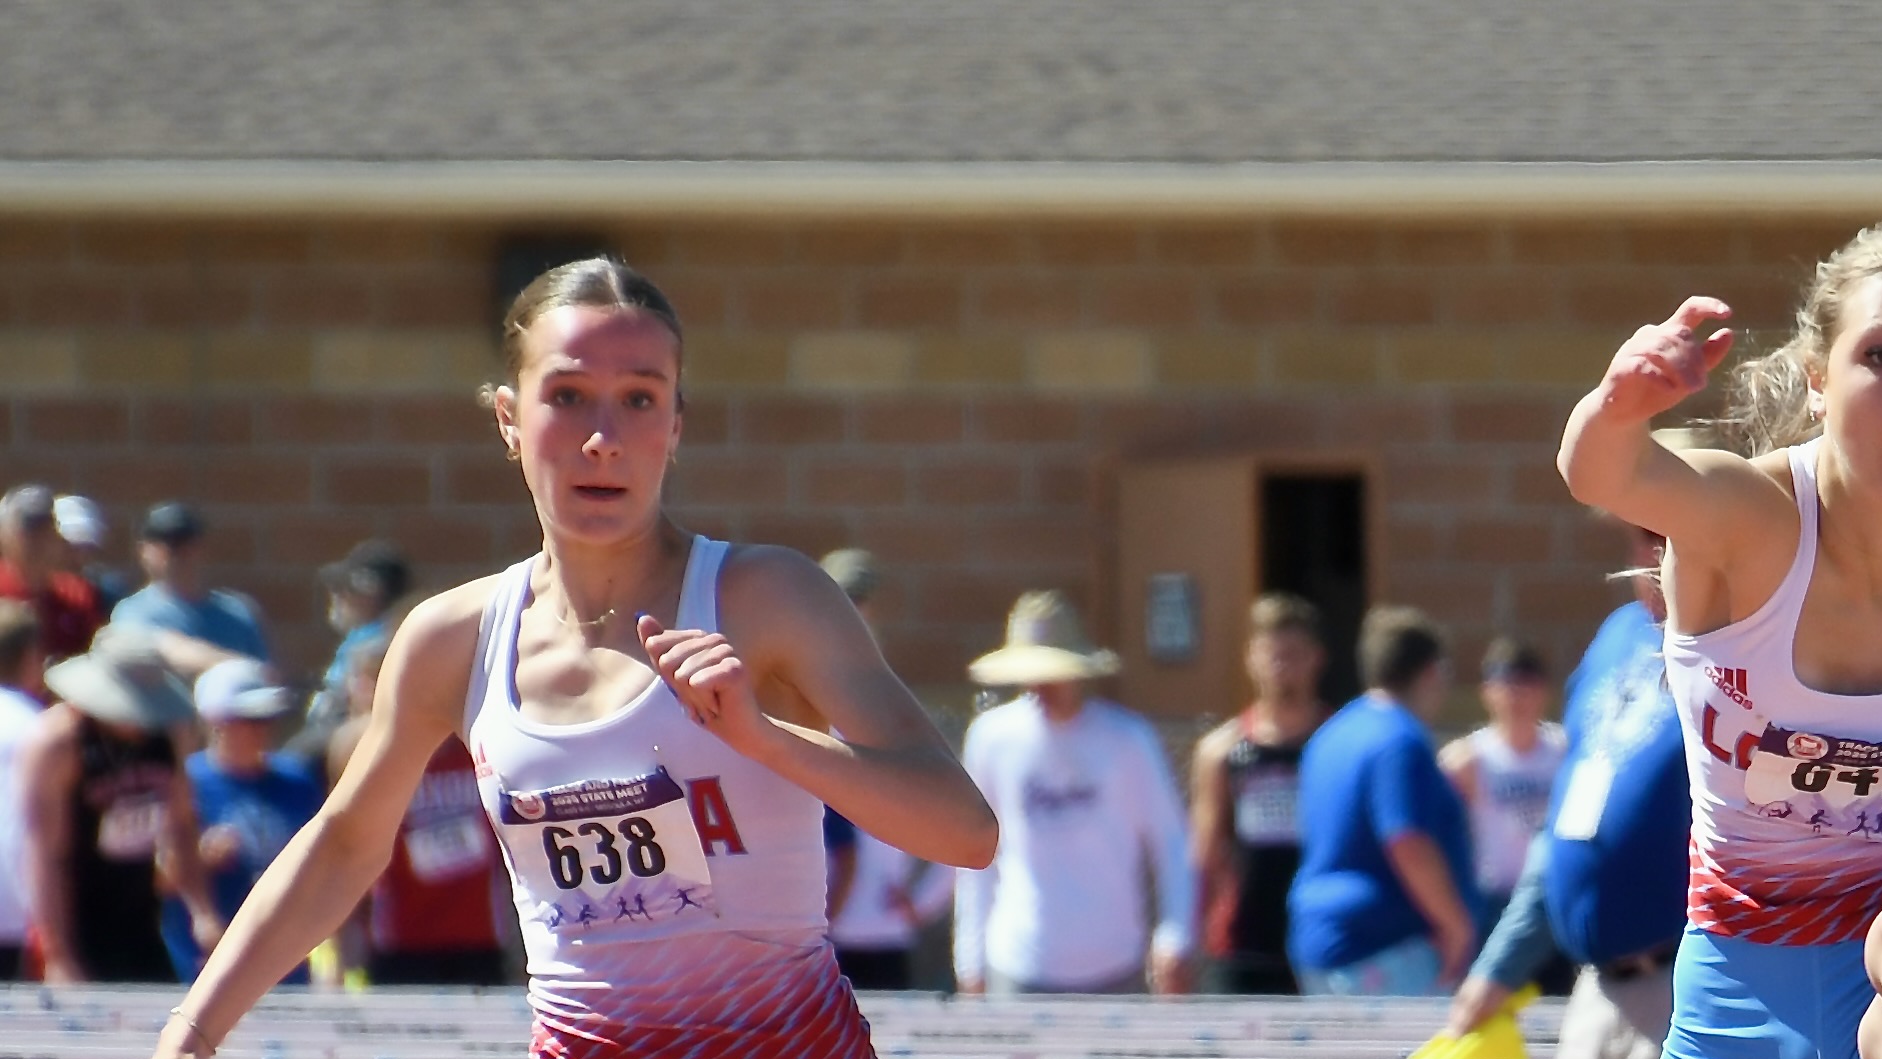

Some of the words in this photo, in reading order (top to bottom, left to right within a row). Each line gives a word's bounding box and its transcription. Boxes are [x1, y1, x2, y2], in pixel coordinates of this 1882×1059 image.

[1704, 666, 1753, 710] adidas
[615, 783, 648, 799] MEET
[542, 816, 667, 890] 638
